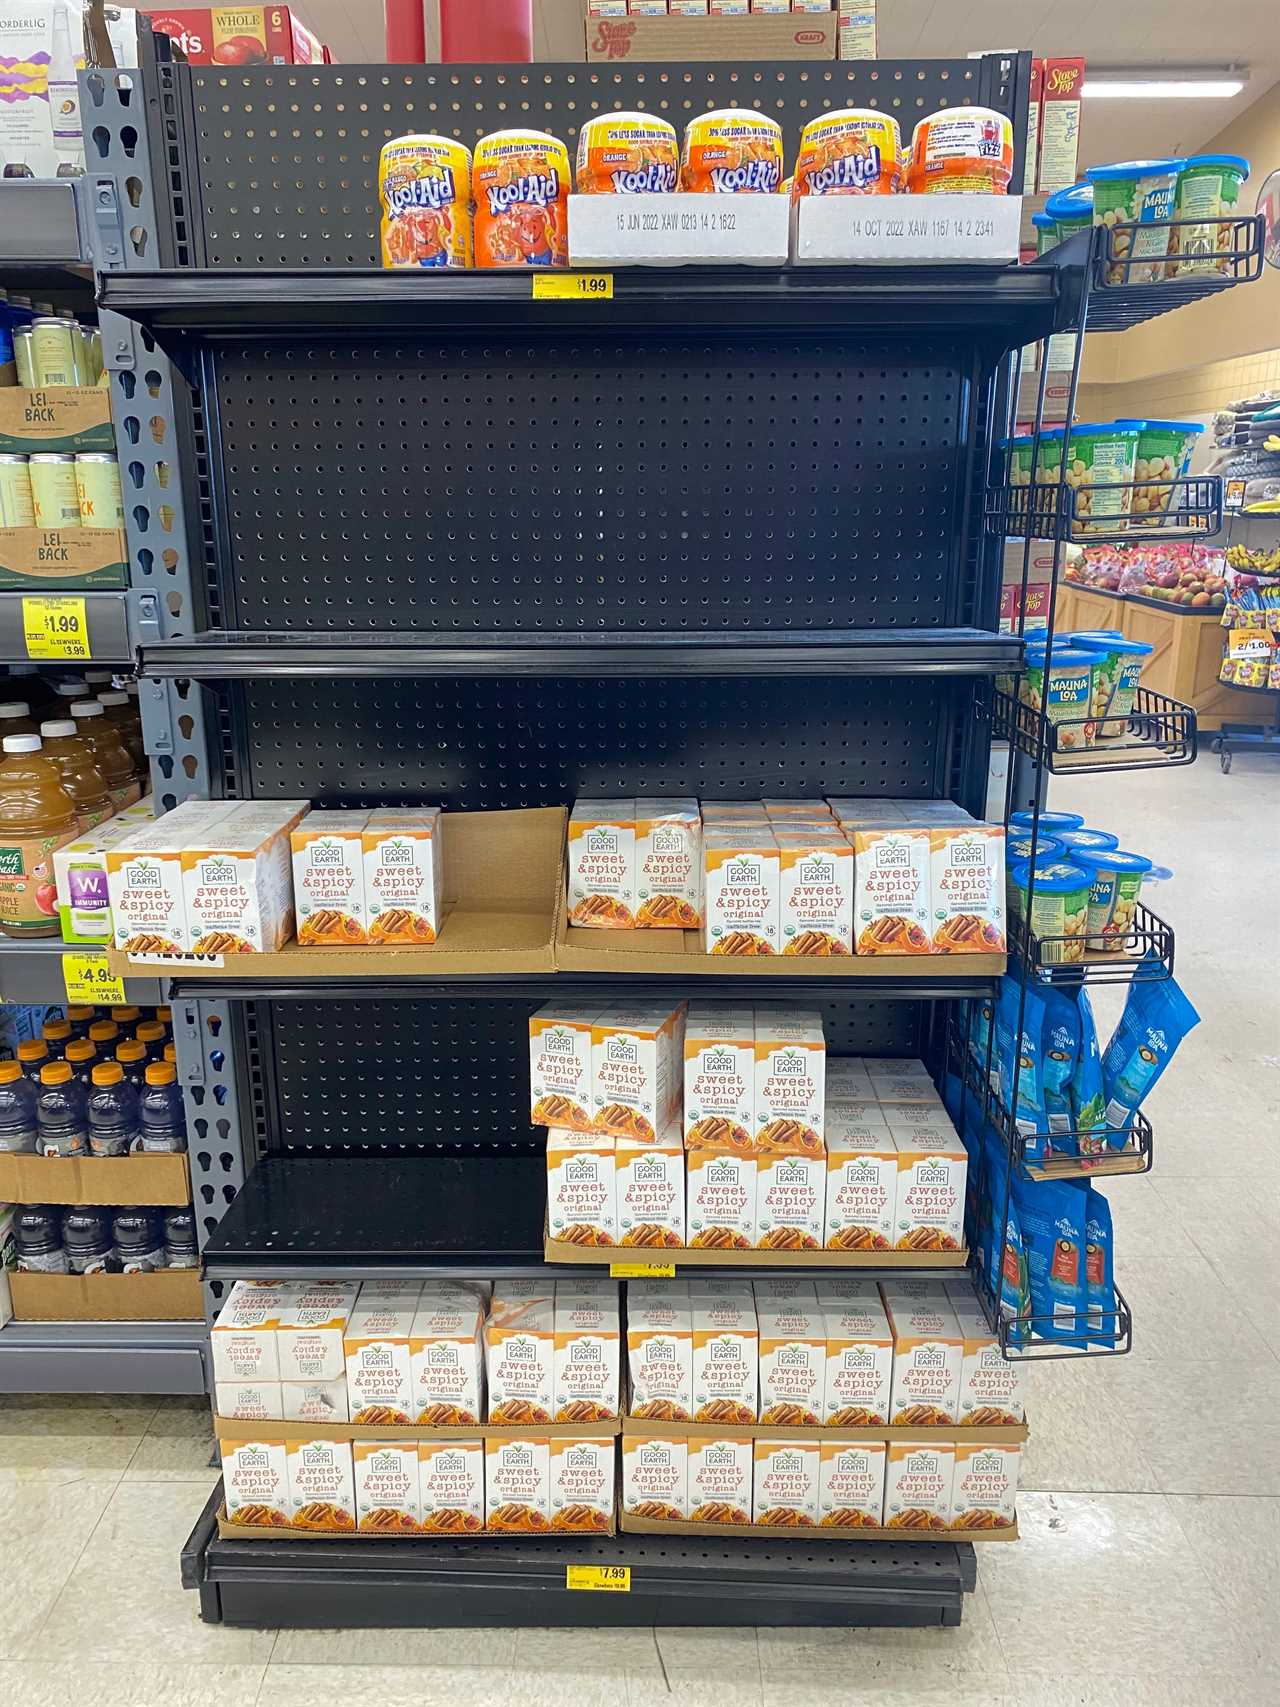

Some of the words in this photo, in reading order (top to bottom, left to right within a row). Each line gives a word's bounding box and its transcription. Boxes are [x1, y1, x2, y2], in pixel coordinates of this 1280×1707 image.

[216, 16, 260, 27] WHOLE
[271, 11, 282, 26] 6
[1047, 68, 1079, 90] Stove
[1057, 81, 1074, 95] Top
[979, 144, 1001, 157] FIZZ
[603, 153, 628, 162] ORANGE
[627, 213, 640, 230] JUN
[643, 213, 659, 230] 2022
[661, 213, 679, 230] XAW
[701, 213, 708, 230] 14
[711, 213, 716, 230] 2
[852, 220, 861, 237] 14
[865, 220, 882, 237] OCT
[886, 220, 904, 237] 2022
[908, 220, 928, 237] XAW
[954, 220, 963, 237] 14
[966, 220, 972, 237] 2
[30, 393, 47, 407] LEI
[25, 408, 56, 421] BACK
[81, 501, 95, 516] CK
[43, 533, 61, 546] LEI
[38, 548, 69, 561] BACK
[44, 615, 79, 633] $1.99
[1050, 679, 1088, 692] MAUNA
[1060, 691, 1078, 702] LOA
[306, 867, 351, 876] sweet
[945, 867, 992, 877] sweet
[123, 890, 170, 899] sweet
[721, 886, 768, 896] sweet
[948, 892, 989, 900] original
[75, 898, 108, 907] IMMUNITY
[724, 910, 763, 918] original
[610, 1045, 634, 1053] GOOD
[602, 1063, 644, 1074] sweet
[697, 1075, 742, 1084] sweet
[605, 1084, 640, 1094] original
[700, 1097, 738, 1105] original
[701, 1186, 745, 1195] sweet
[910, 1186, 955, 1195] sweet
[424, 1367, 465, 1375] sweet
[705, 1362, 747, 1370] sweet
[908, 1369, 950, 1377] sweet
[909, 1387, 945, 1395] original
[299, 1466, 341, 1475] sweet
[498, 1468, 540, 1476] sweet
[700, 1466, 741, 1475] sweet
[600, 1567, 625, 1579] $7.99
